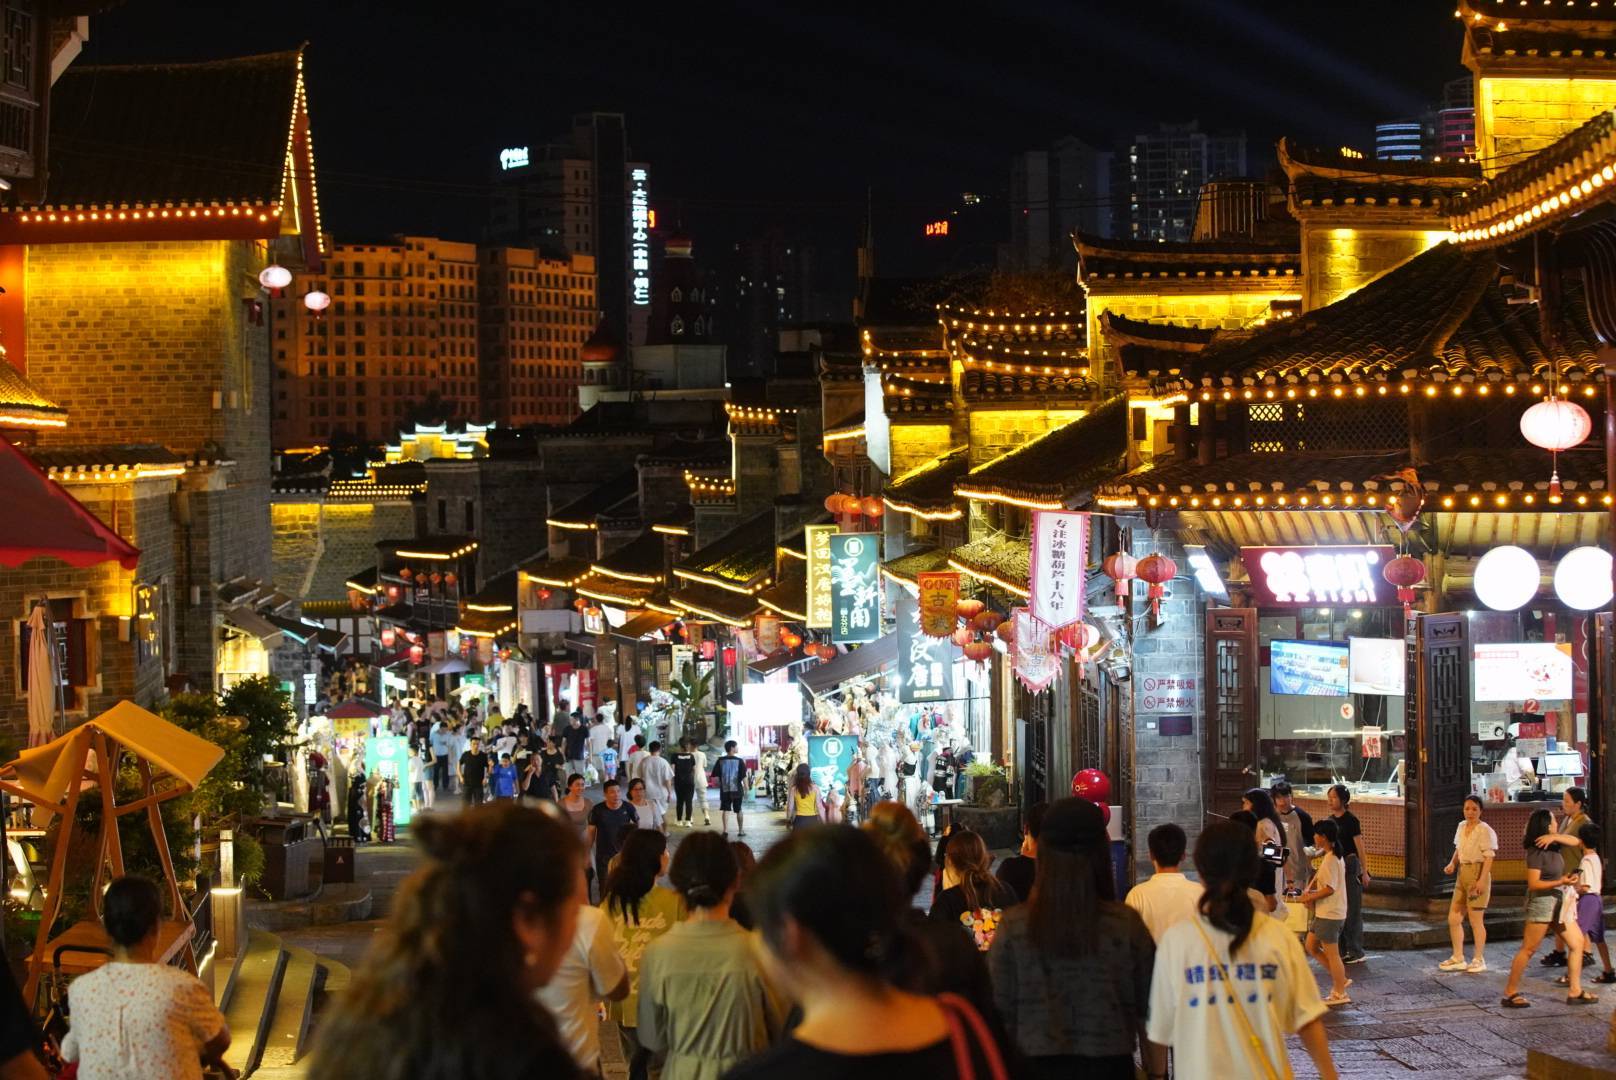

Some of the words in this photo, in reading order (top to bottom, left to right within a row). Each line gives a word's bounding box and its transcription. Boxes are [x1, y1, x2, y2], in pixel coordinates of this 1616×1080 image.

[1050, 518, 1068, 611] 专注冰糖葫芦十八年
[1156, 678, 1195, 690] 严禁吸烟
[1156, 697, 1195, 708] 严禁烟火
[1526, 700, 1537, 713] 2
